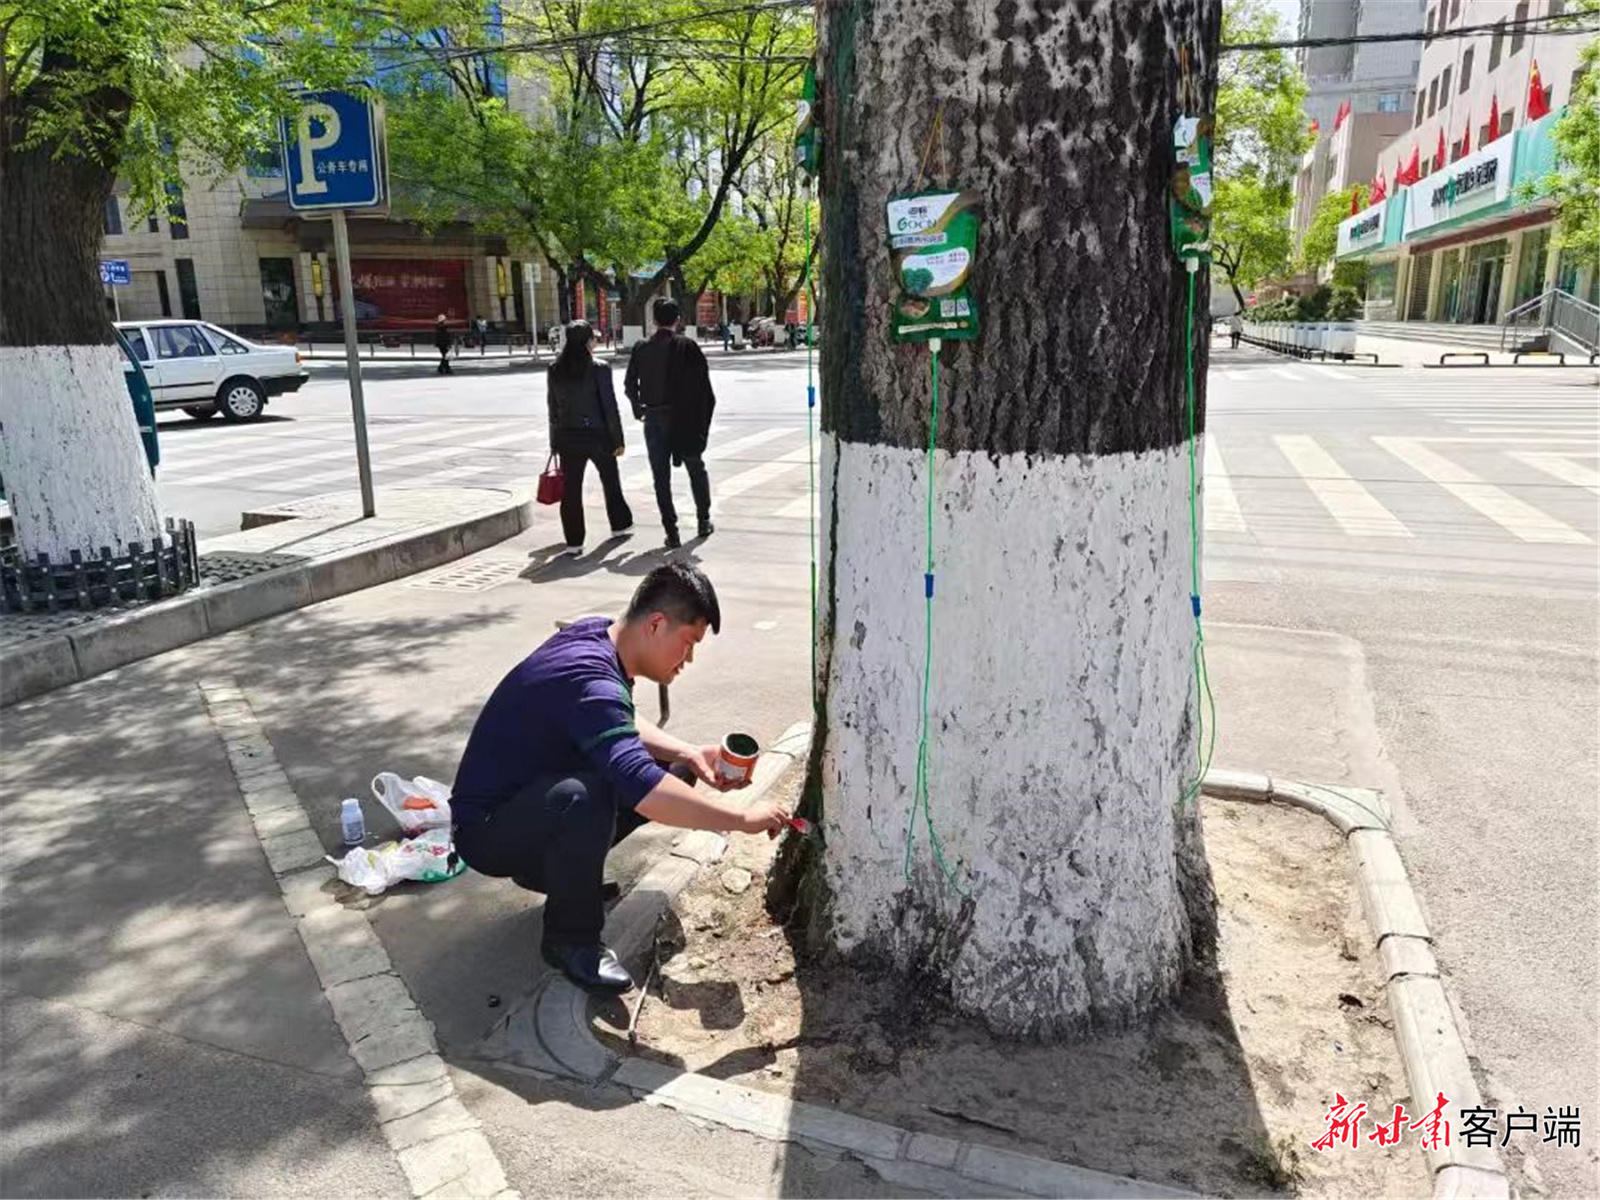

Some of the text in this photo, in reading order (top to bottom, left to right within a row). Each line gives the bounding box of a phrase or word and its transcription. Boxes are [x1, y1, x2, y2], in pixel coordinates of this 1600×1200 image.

[297, 103, 341, 195] P
[316, 159, 368, 174] 公务车专用
